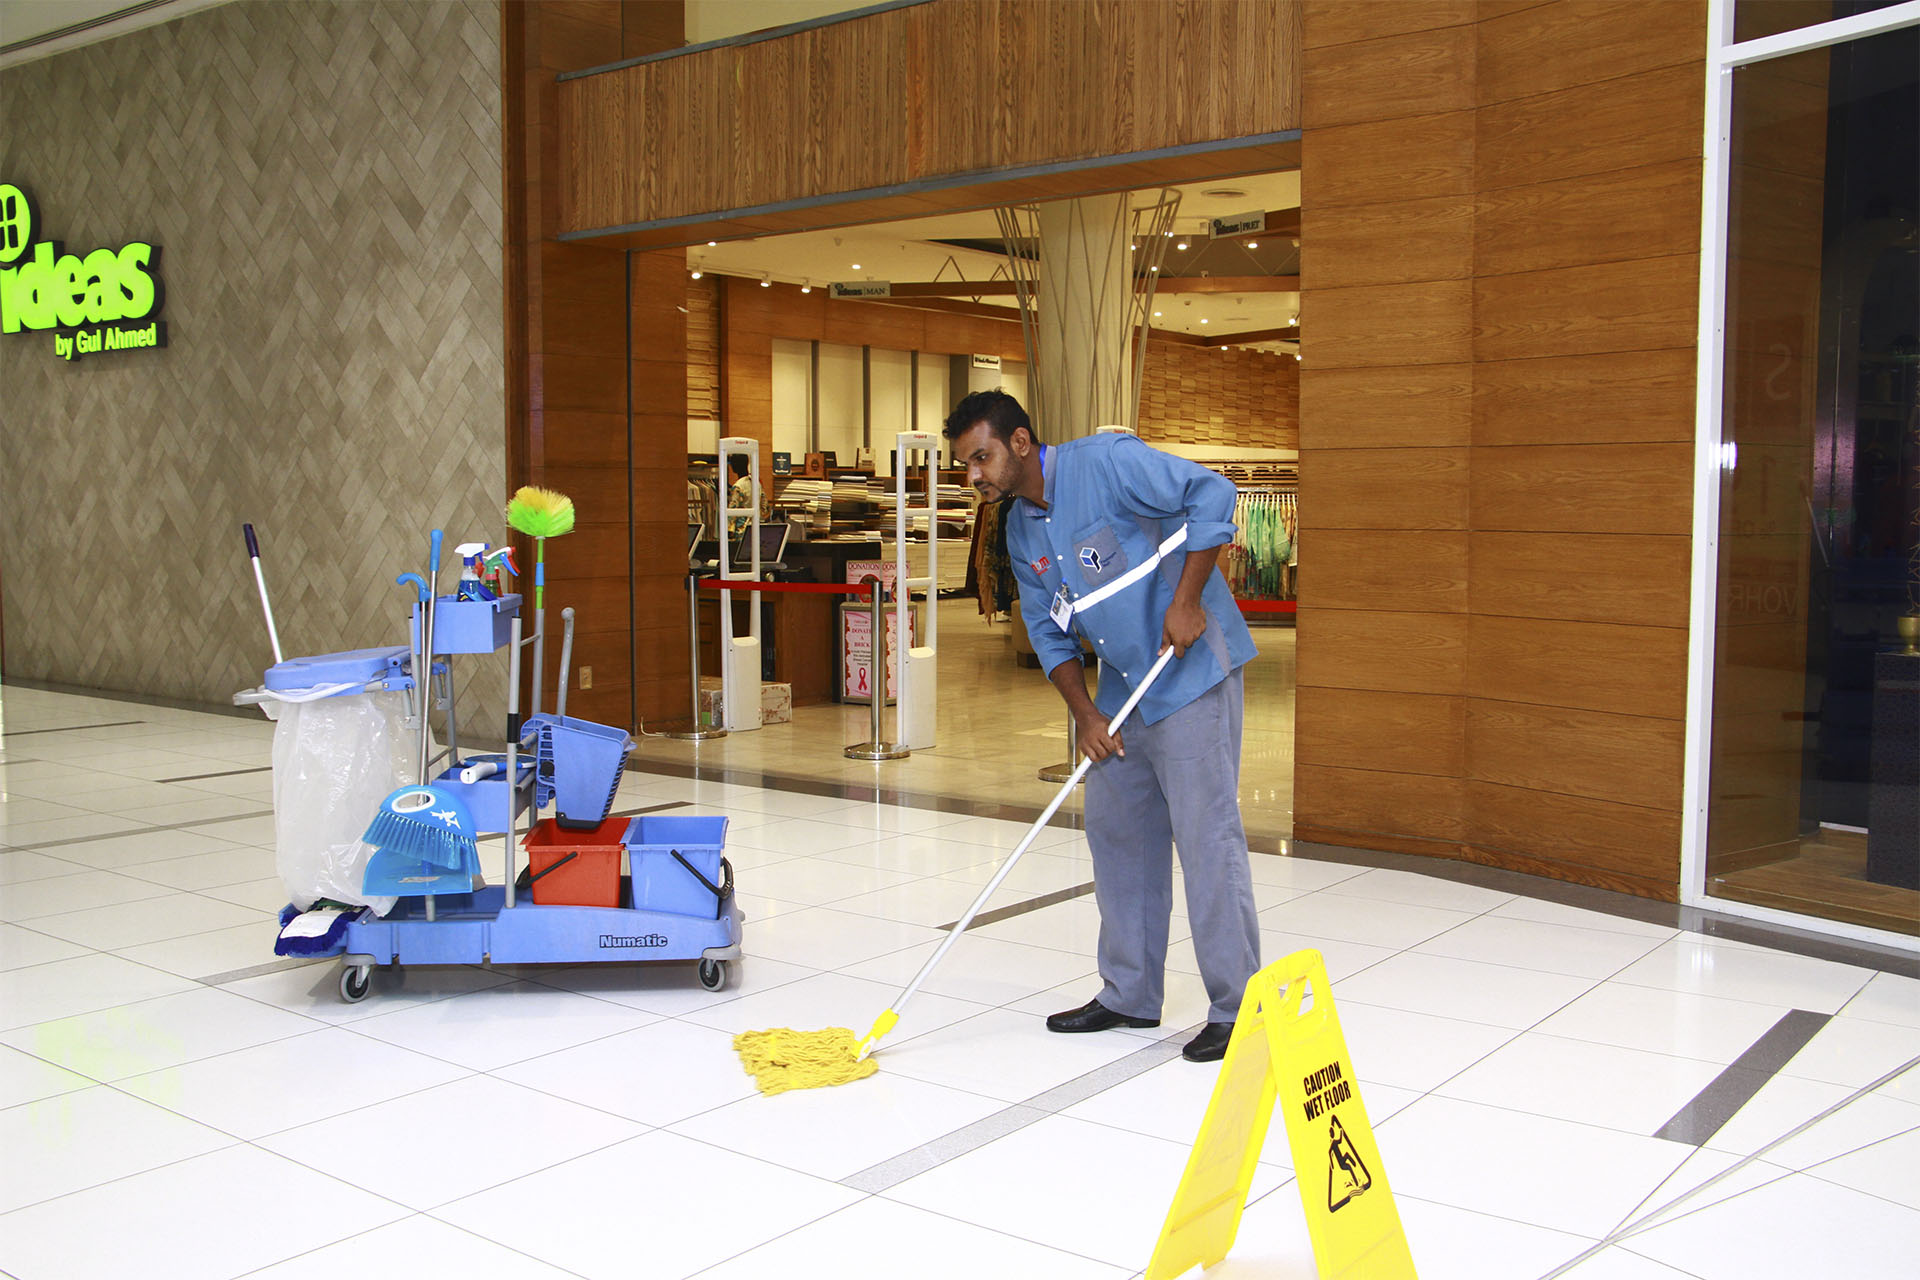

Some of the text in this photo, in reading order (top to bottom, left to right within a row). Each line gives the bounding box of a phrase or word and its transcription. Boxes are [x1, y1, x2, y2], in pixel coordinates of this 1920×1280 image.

[55, 322, 157, 360] by Gul Ahmed
[848, 562, 880, 570] DONATION
[600, 934, 668, 948] Numatic
[1303, 1060, 1342, 1097] CAUTION
[1303, 1080, 1352, 1122] WET FLOOR
